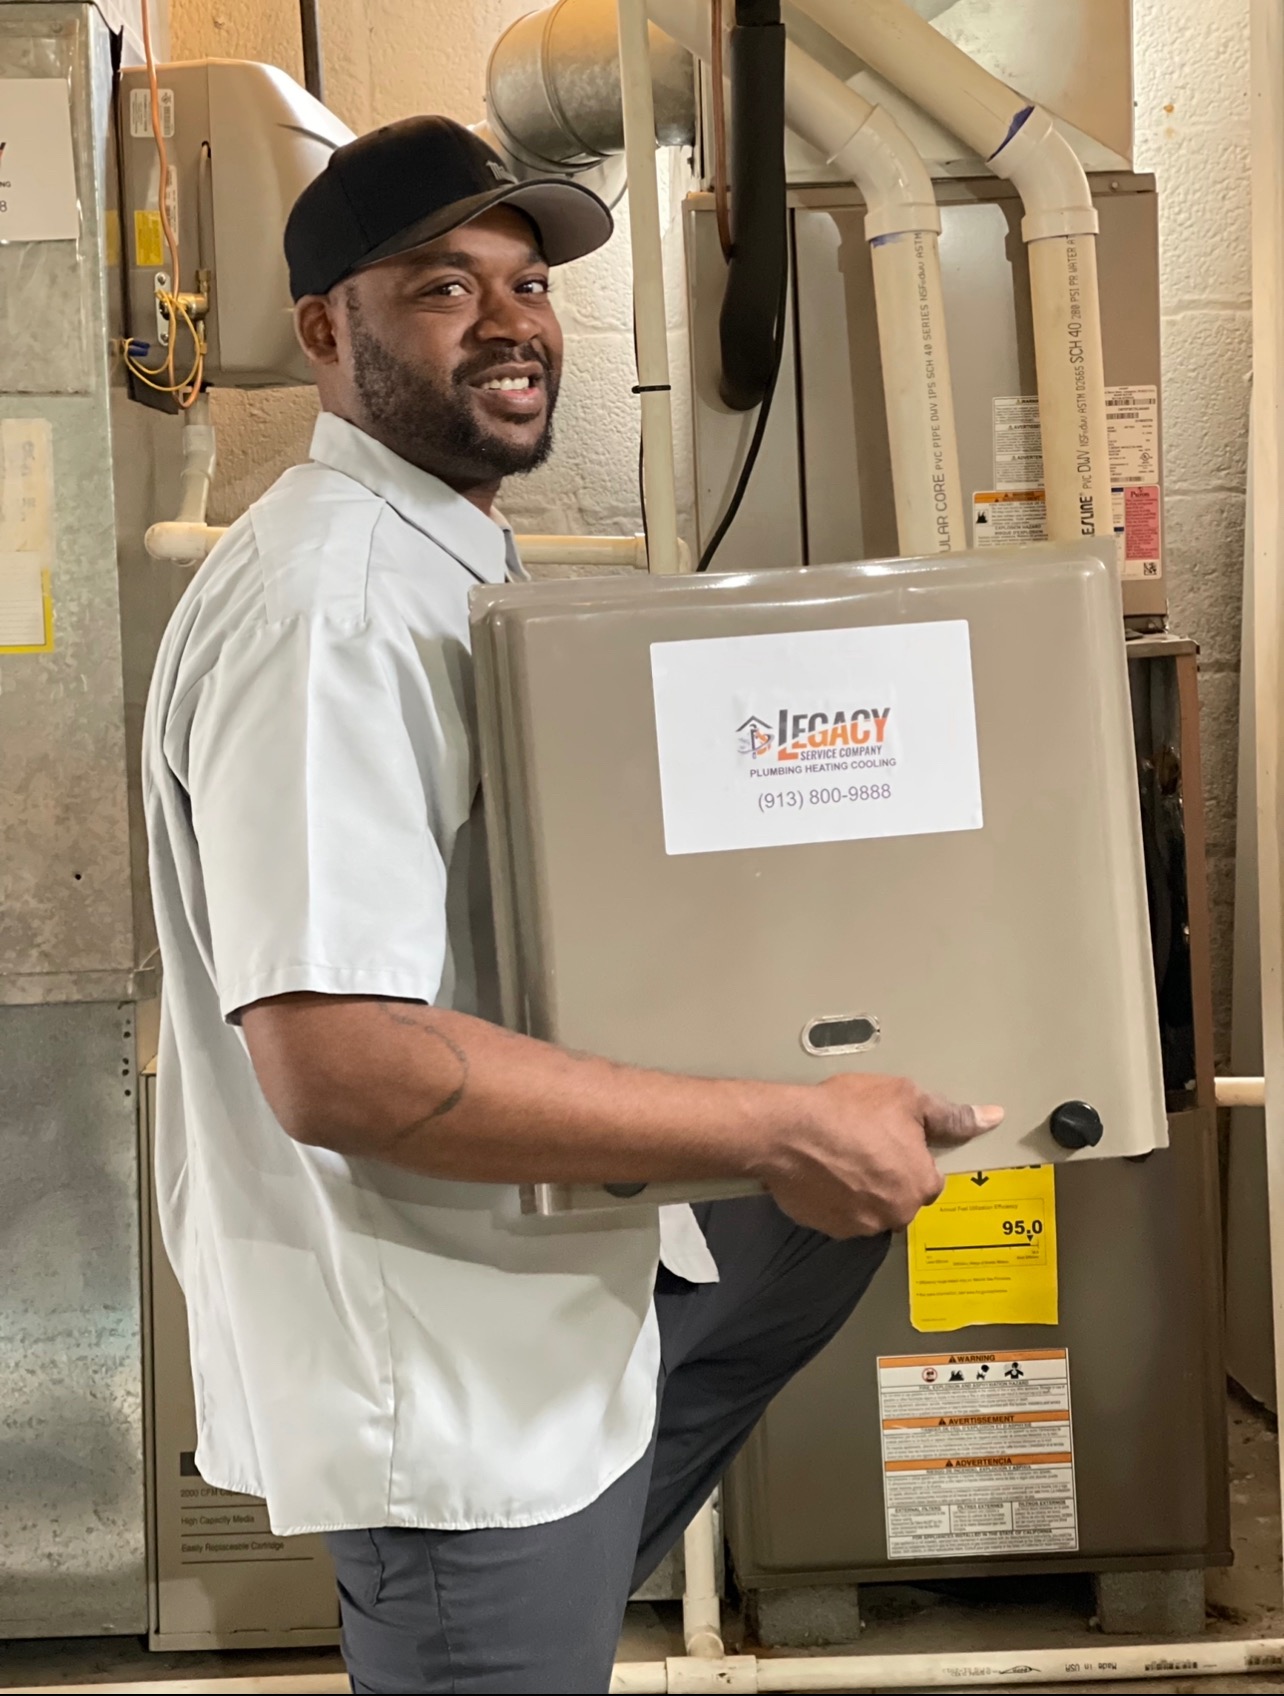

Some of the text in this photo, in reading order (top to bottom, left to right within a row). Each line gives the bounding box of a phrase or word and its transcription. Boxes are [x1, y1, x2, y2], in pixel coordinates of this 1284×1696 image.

[914, 232, 924, 258] ASTM
[919, 304, 932, 342] SERIES
[1068, 322, 1082, 338] 40
[924, 344, 932, 357] 40
[1070, 339, 1084, 364] SCH
[926, 360, 935, 380] SCH
[1076, 393, 1088, 413] ASTM
[931, 424, 942, 448] PIPE
[933, 451, 944, 471] PVC
[932, 473, 948, 512] CORE
[778, 707, 890, 761] LEGACY
[800, 745, 882, 761] SERVICE COMPANY
[750, 758, 896, 778] PLUMBING HEATING COOLING
[758, 783, 892, 812] (913) 800-9888
[1002, 1220, 1042, 1236] 95.0
[957, 1354, 996, 1362] WARNING
[948, 1416, 1014, 1425] AVERTISSEMENT
[956, 1458, 1012, 1467] ADVERTENCIA
[181, 1518, 198, 1526] High
